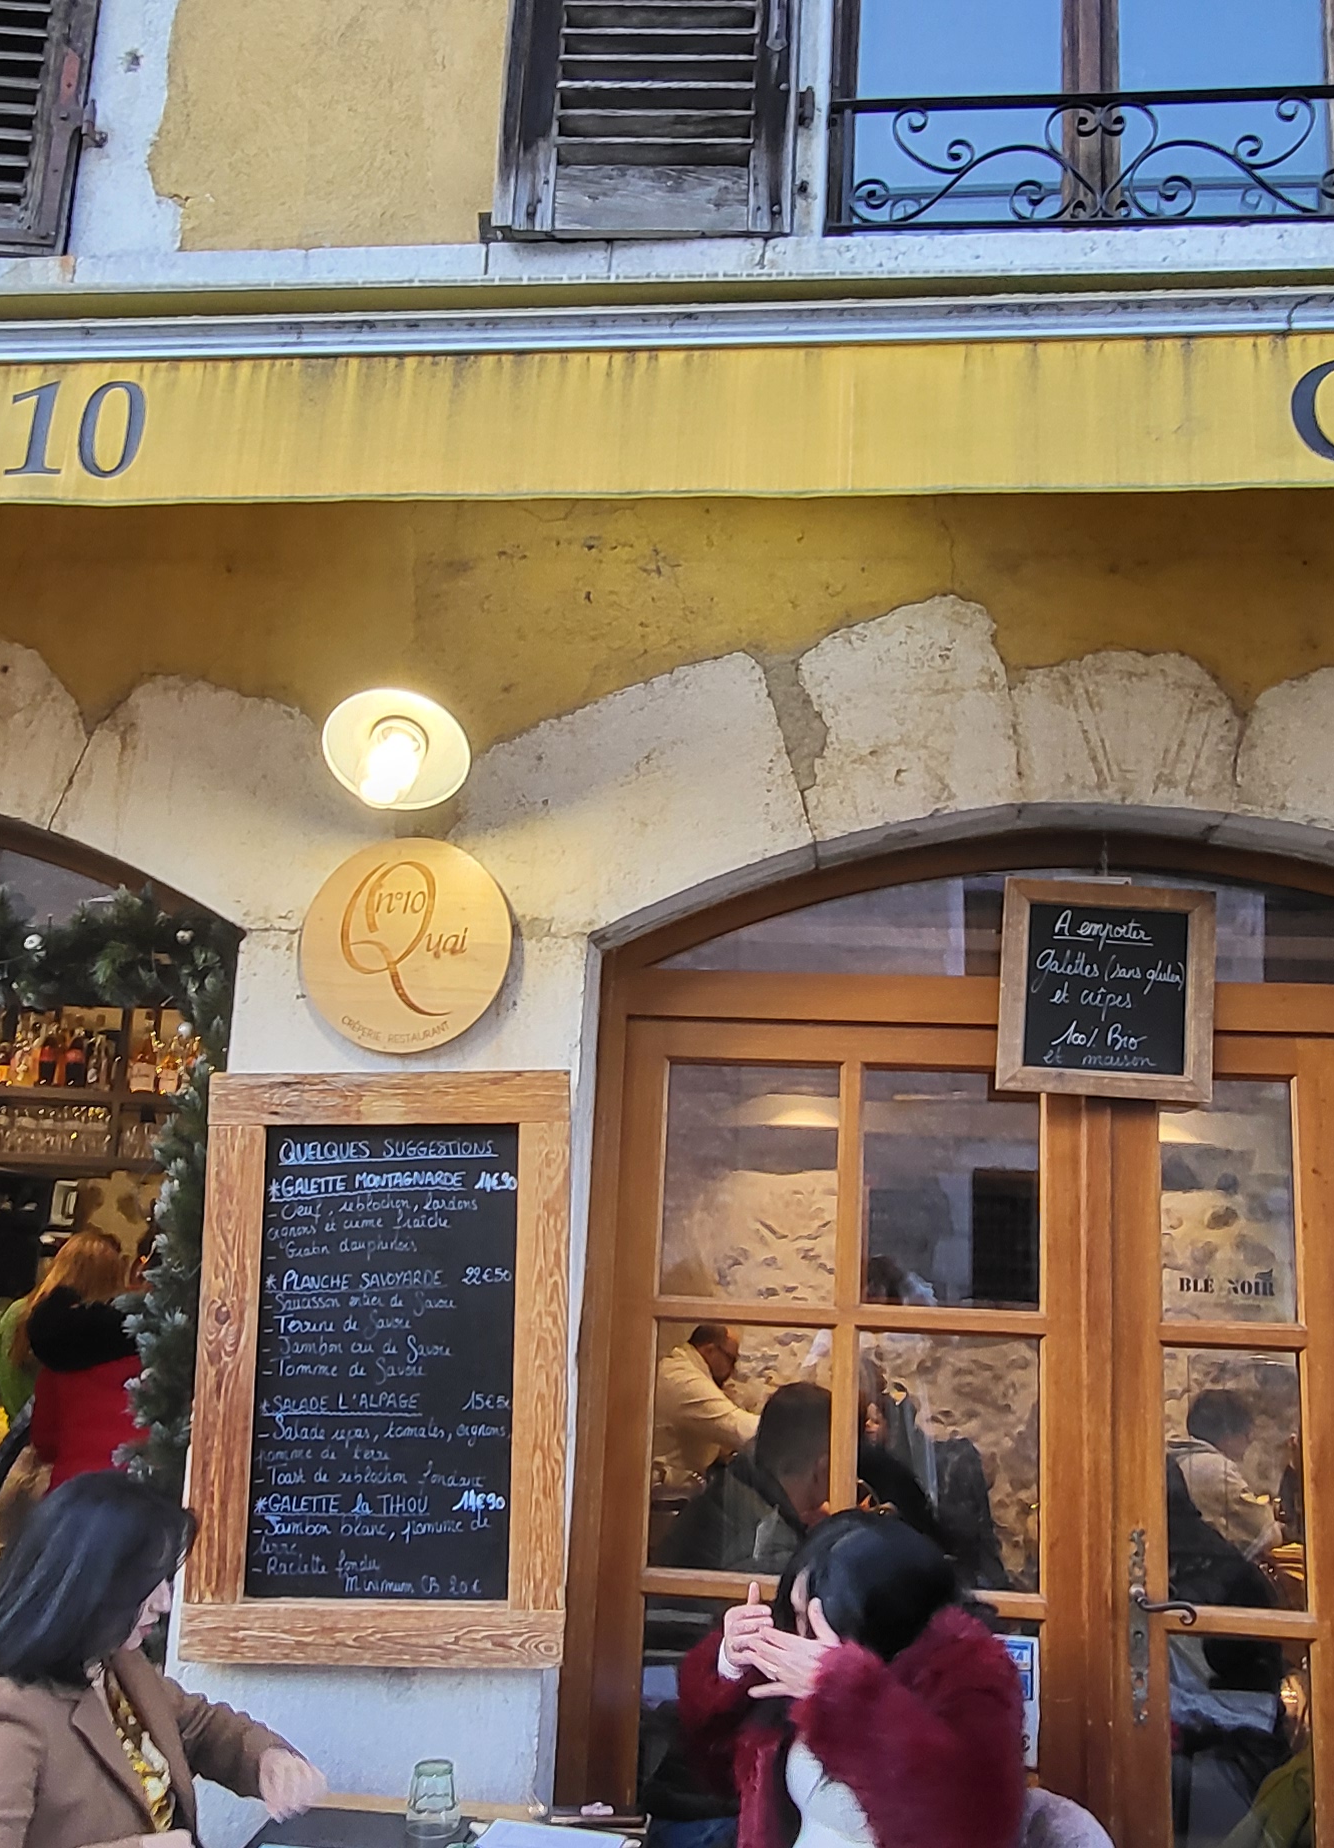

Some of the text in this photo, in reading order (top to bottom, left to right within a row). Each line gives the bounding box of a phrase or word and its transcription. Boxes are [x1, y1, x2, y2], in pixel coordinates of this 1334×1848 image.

[1054, 910, 1152, 951] A emporter
[1050, 981, 1070, 1004] et
[387, 1020, 450, 1044] RESTAURANT
[1043, 1047, 1157, 1067] et maison
[278, 1138, 494, 1163] QUELQUES SUGGESTIONS
[281, 1175, 347, 1197] GALETTE
[354, 1171, 466, 1190] MONTAGNARDE
[281, 1269, 350, 1291] PLANCHE
[359, 1270, 444, 1289] SAVOYARDE
[1179, 1275, 1214, 1294] BLÉ
[272, 1395, 329, 1413] SALADE
[268, 1494, 342, 1514] GALETTE
